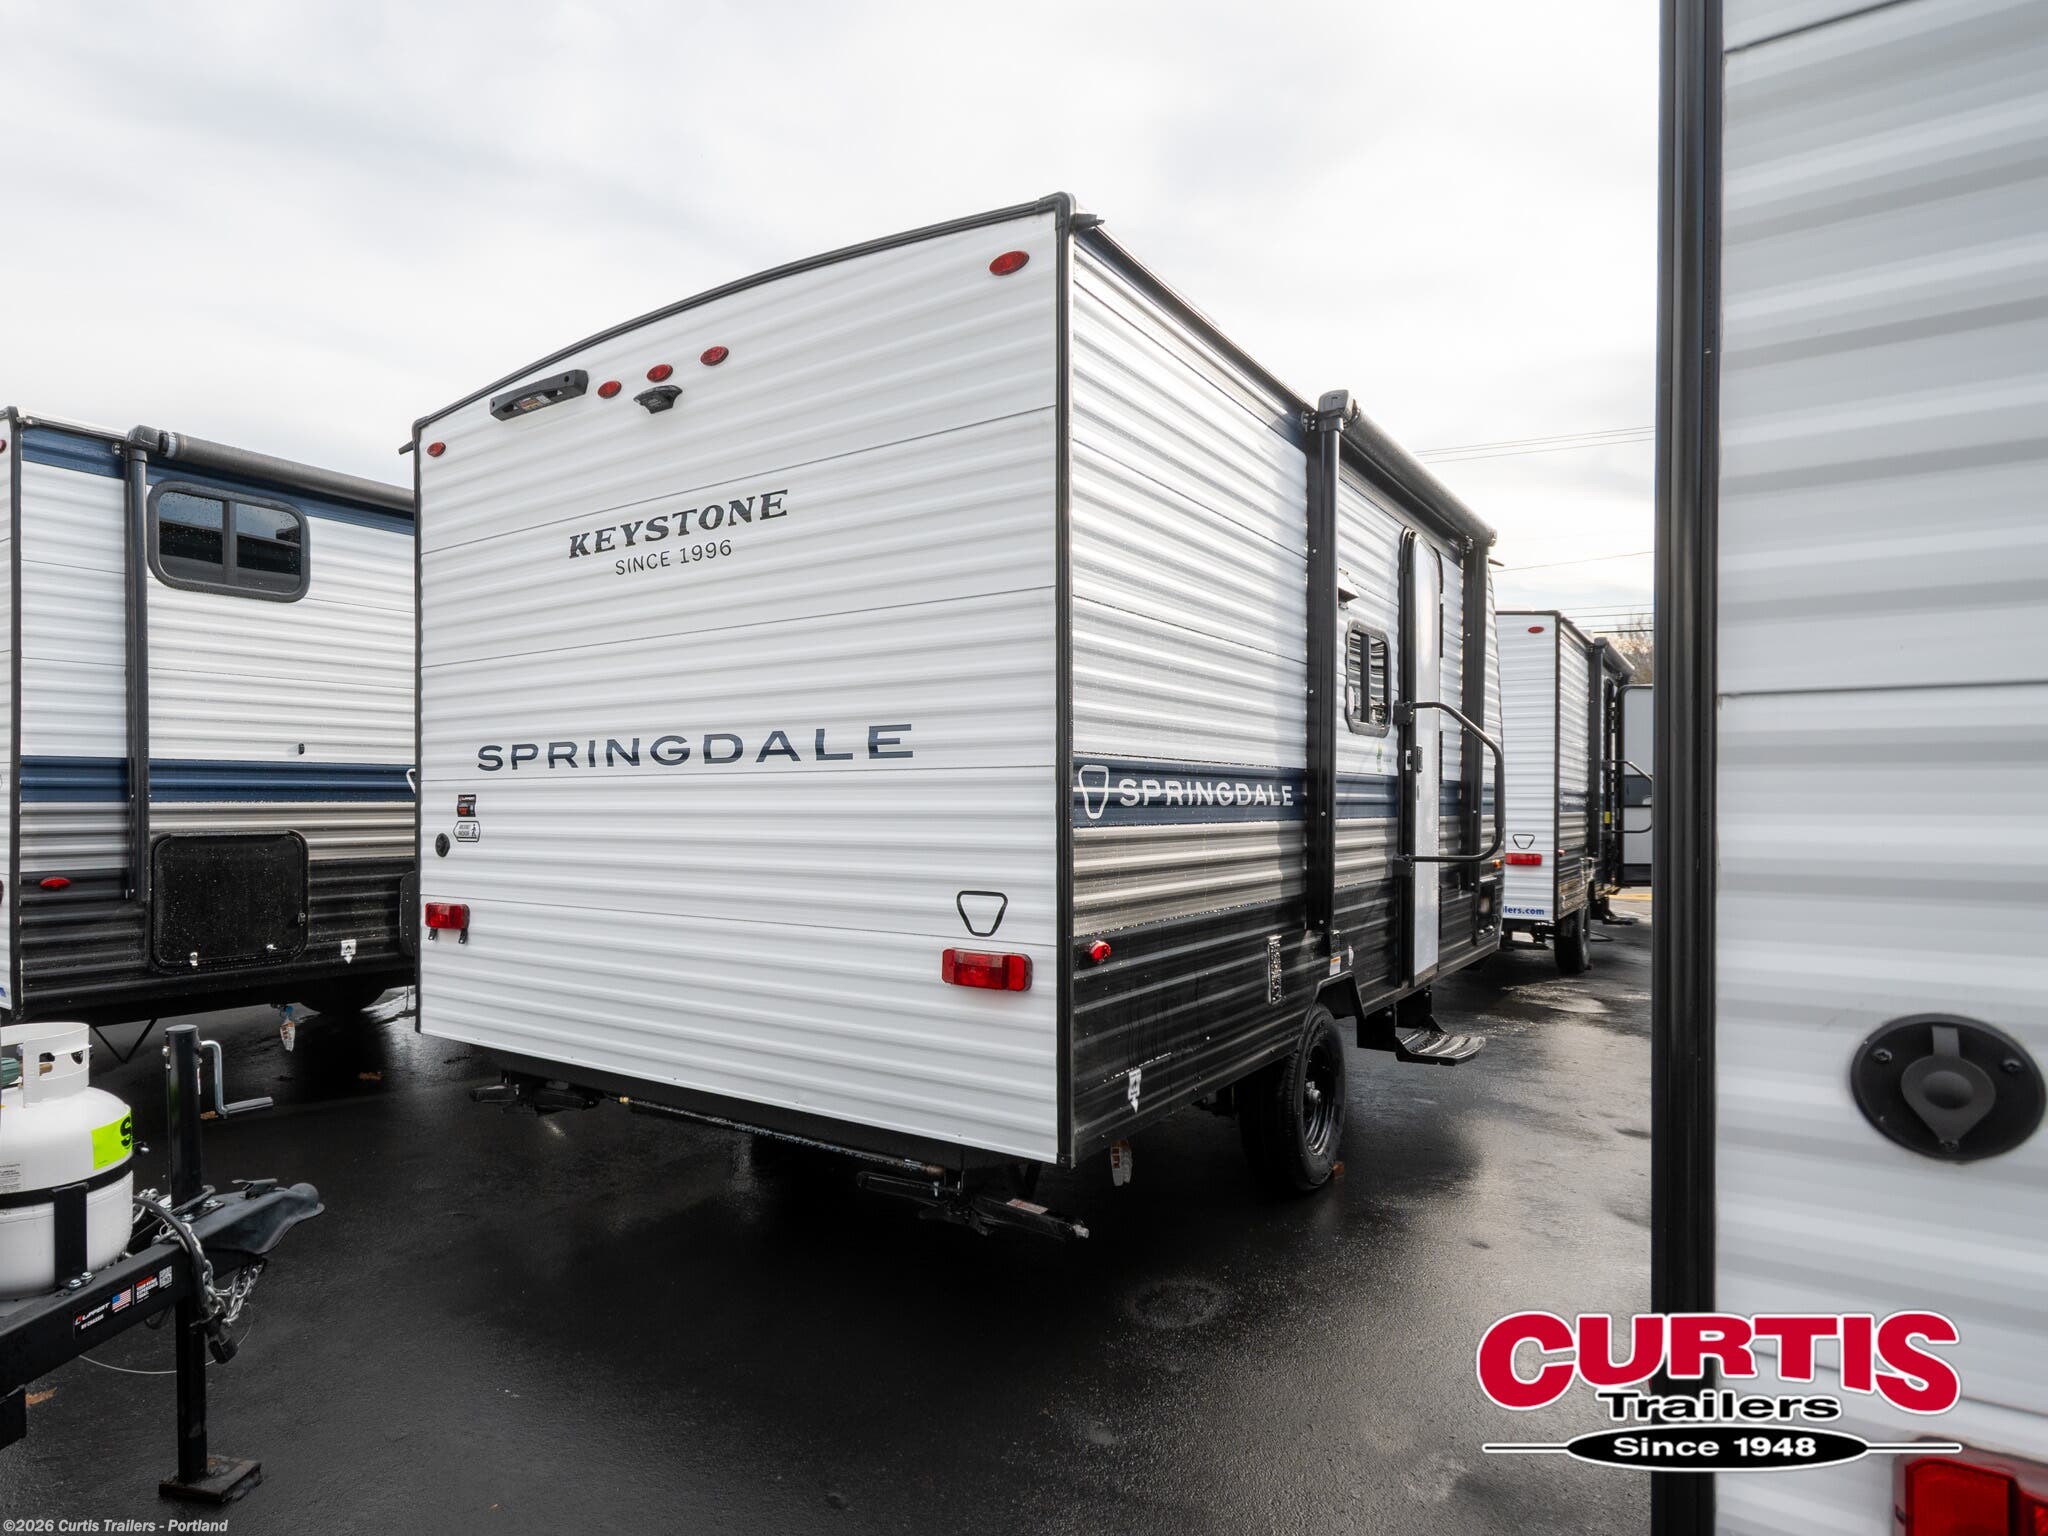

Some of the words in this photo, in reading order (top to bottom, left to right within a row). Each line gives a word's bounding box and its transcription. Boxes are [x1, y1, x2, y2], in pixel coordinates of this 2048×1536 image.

[568, 490, 788, 558] KEYSTONE
[615, 554, 671, 575] SINCE
[679, 540, 732, 564] 1996
[477, 724, 913, 771] SPRINGDALE
[1118, 778, 1293, 807] SPRINGDALE
